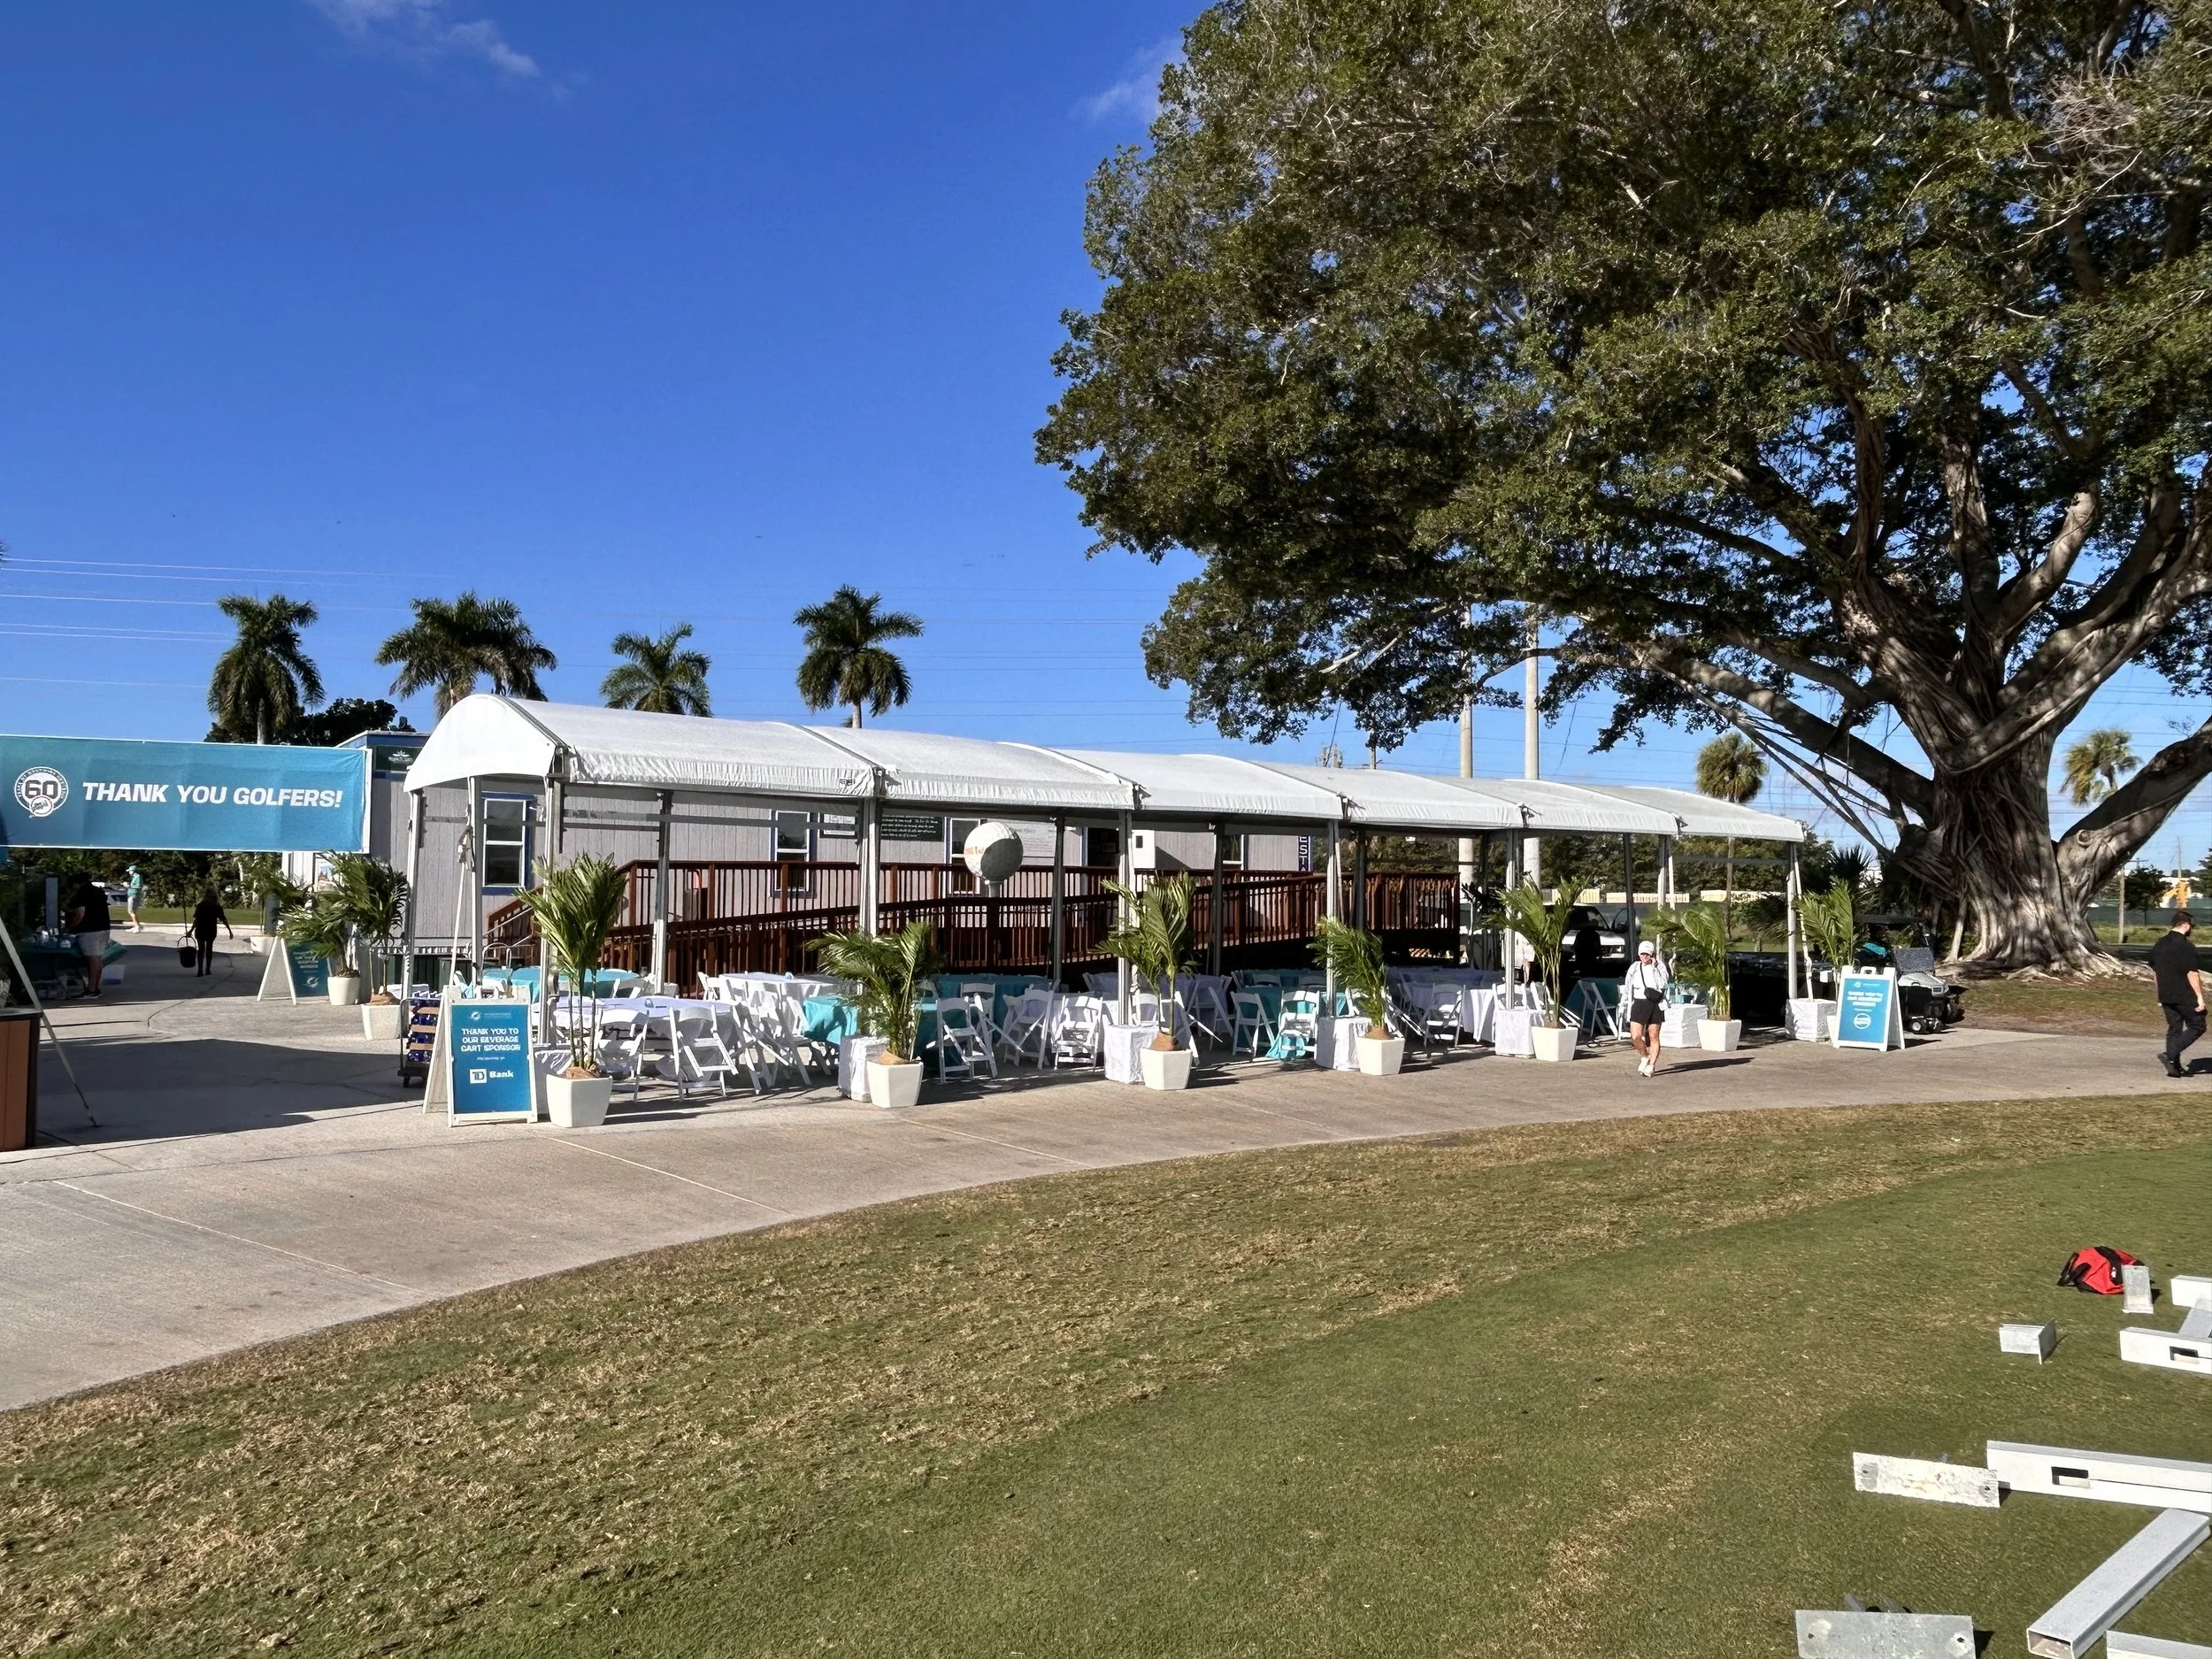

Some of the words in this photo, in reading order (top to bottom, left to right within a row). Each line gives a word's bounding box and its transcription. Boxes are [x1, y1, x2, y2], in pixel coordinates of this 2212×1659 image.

[25, 780, 58, 800] 60
[82, 782, 169, 803] THANK
[176, 785, 227, 804] YOU
[233, 787, 343, 808] GOLFERS!
[472, 1071, 485, 1080] TD
